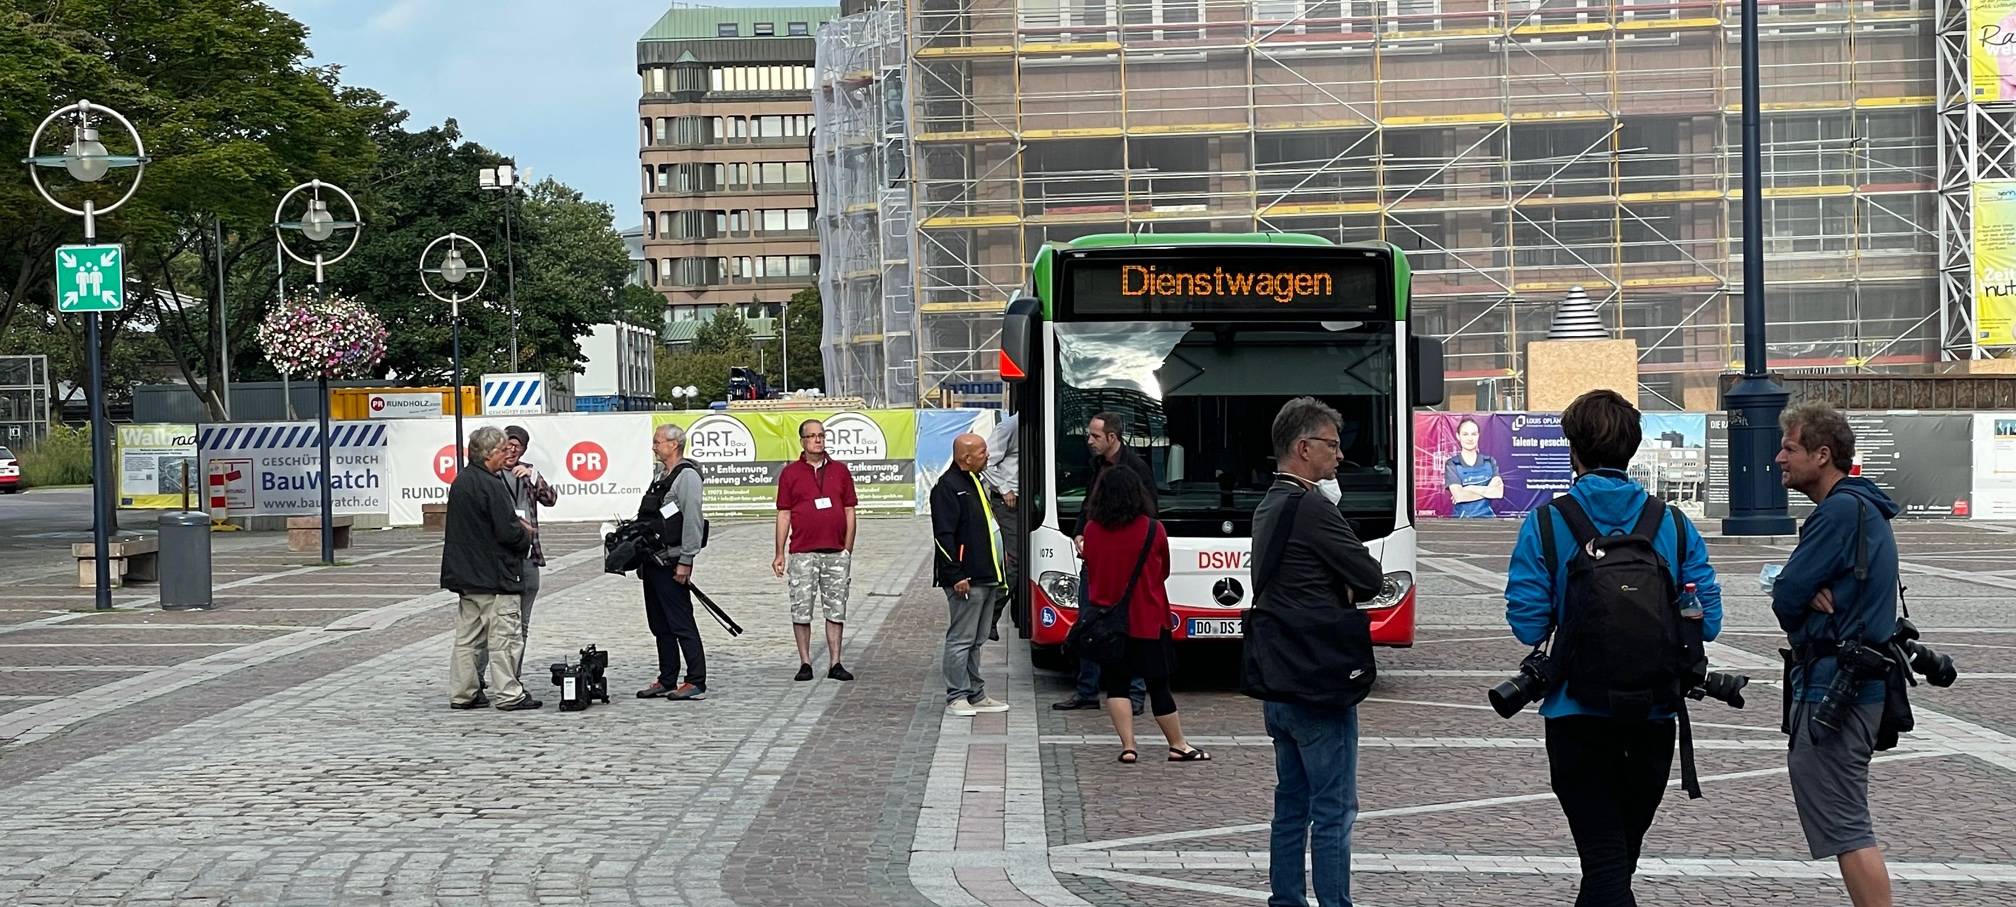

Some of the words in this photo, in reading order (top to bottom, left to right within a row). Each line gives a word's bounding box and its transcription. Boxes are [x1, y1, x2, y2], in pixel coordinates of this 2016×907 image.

[1122, 265, 1333, 303] Dienstwagen
[1985, 280, 2016, 297] nut
[372, 400, 384, 408] PR
[1543, 416, 1562, 424] OPLÄN
[691, 430, 732, 447] ART
[825, 428, 863, 445] ART
[1512, 436, 1538, 447] Talente
[691, 448, 747, 458] GmbH
[824, 445, 877, 455] GmbH
[262, 454, 332, 467] GESCHÜT
[336, 455, 379, 465] DURCH
[572, 452, 601, 472] PR
[717, 465, 768, 475] Entkernung
[848, 462, 899, 473] Entkernung
[748, 475, 773, 483] Solar
[879, 472, 904, 481] Solar
[553, 483, 641, 496] NDHOLZ.com
[263, 497, 379, 509] www.bauatch.de
[1199, 551, 1252, 569] DSW2
[1197, 621, 1211, 634] DO
[1220, 621, 1234, 634] DS
